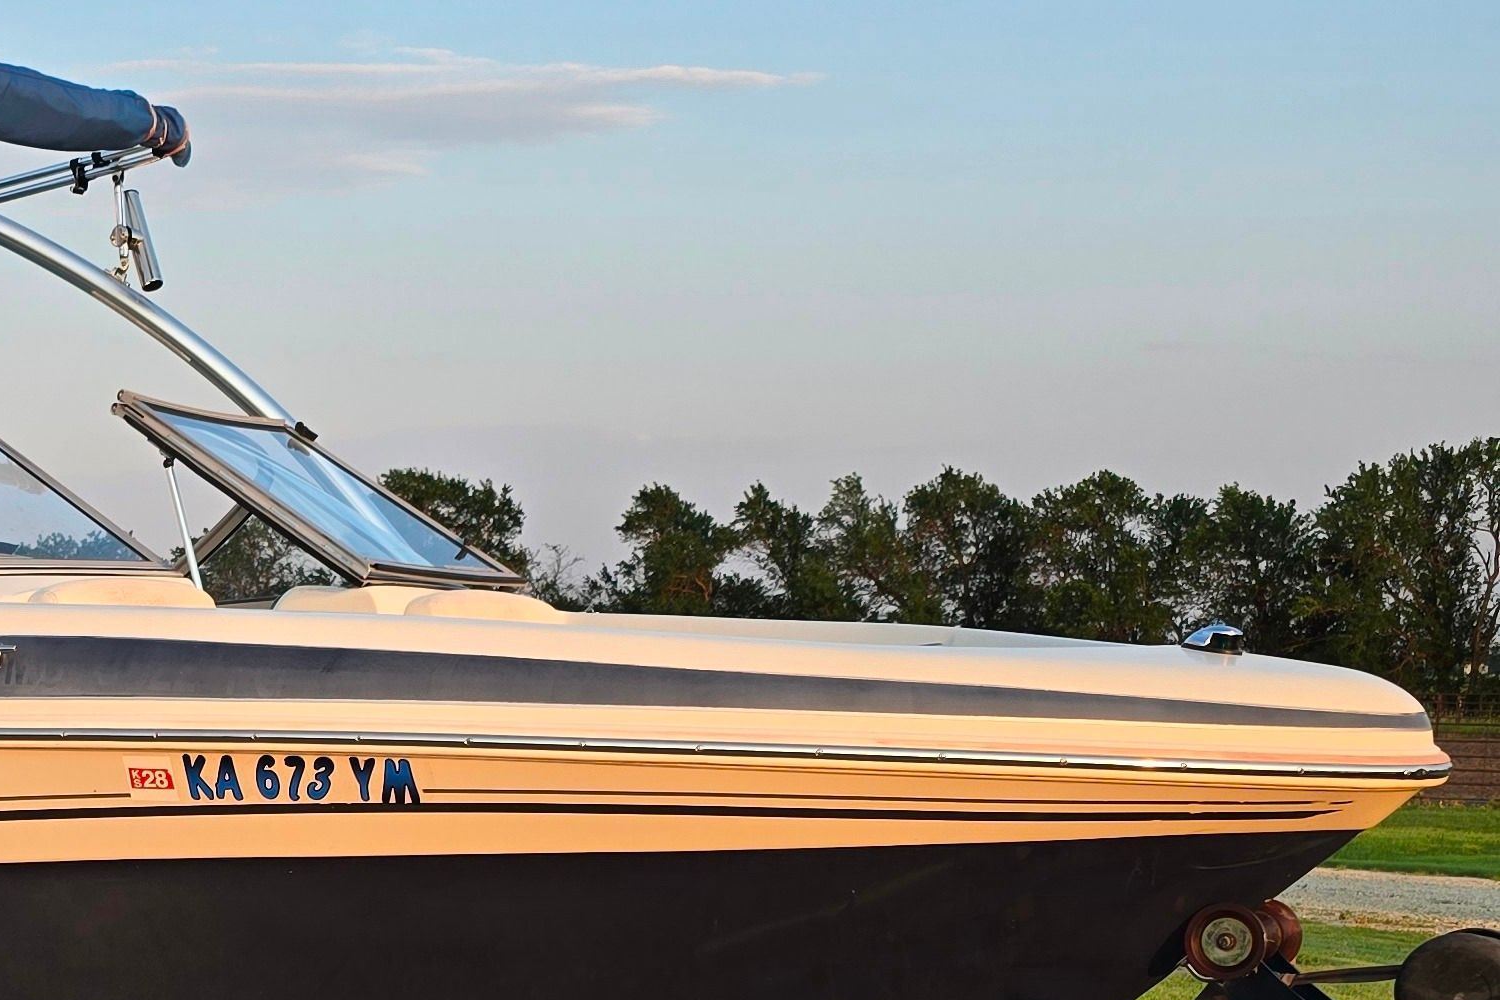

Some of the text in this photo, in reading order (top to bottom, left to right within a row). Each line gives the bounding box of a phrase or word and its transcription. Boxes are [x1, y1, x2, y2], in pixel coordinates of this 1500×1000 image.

[141, 769, 169, 788] 28
[182, 753, 420, 804] KA 673 YM
